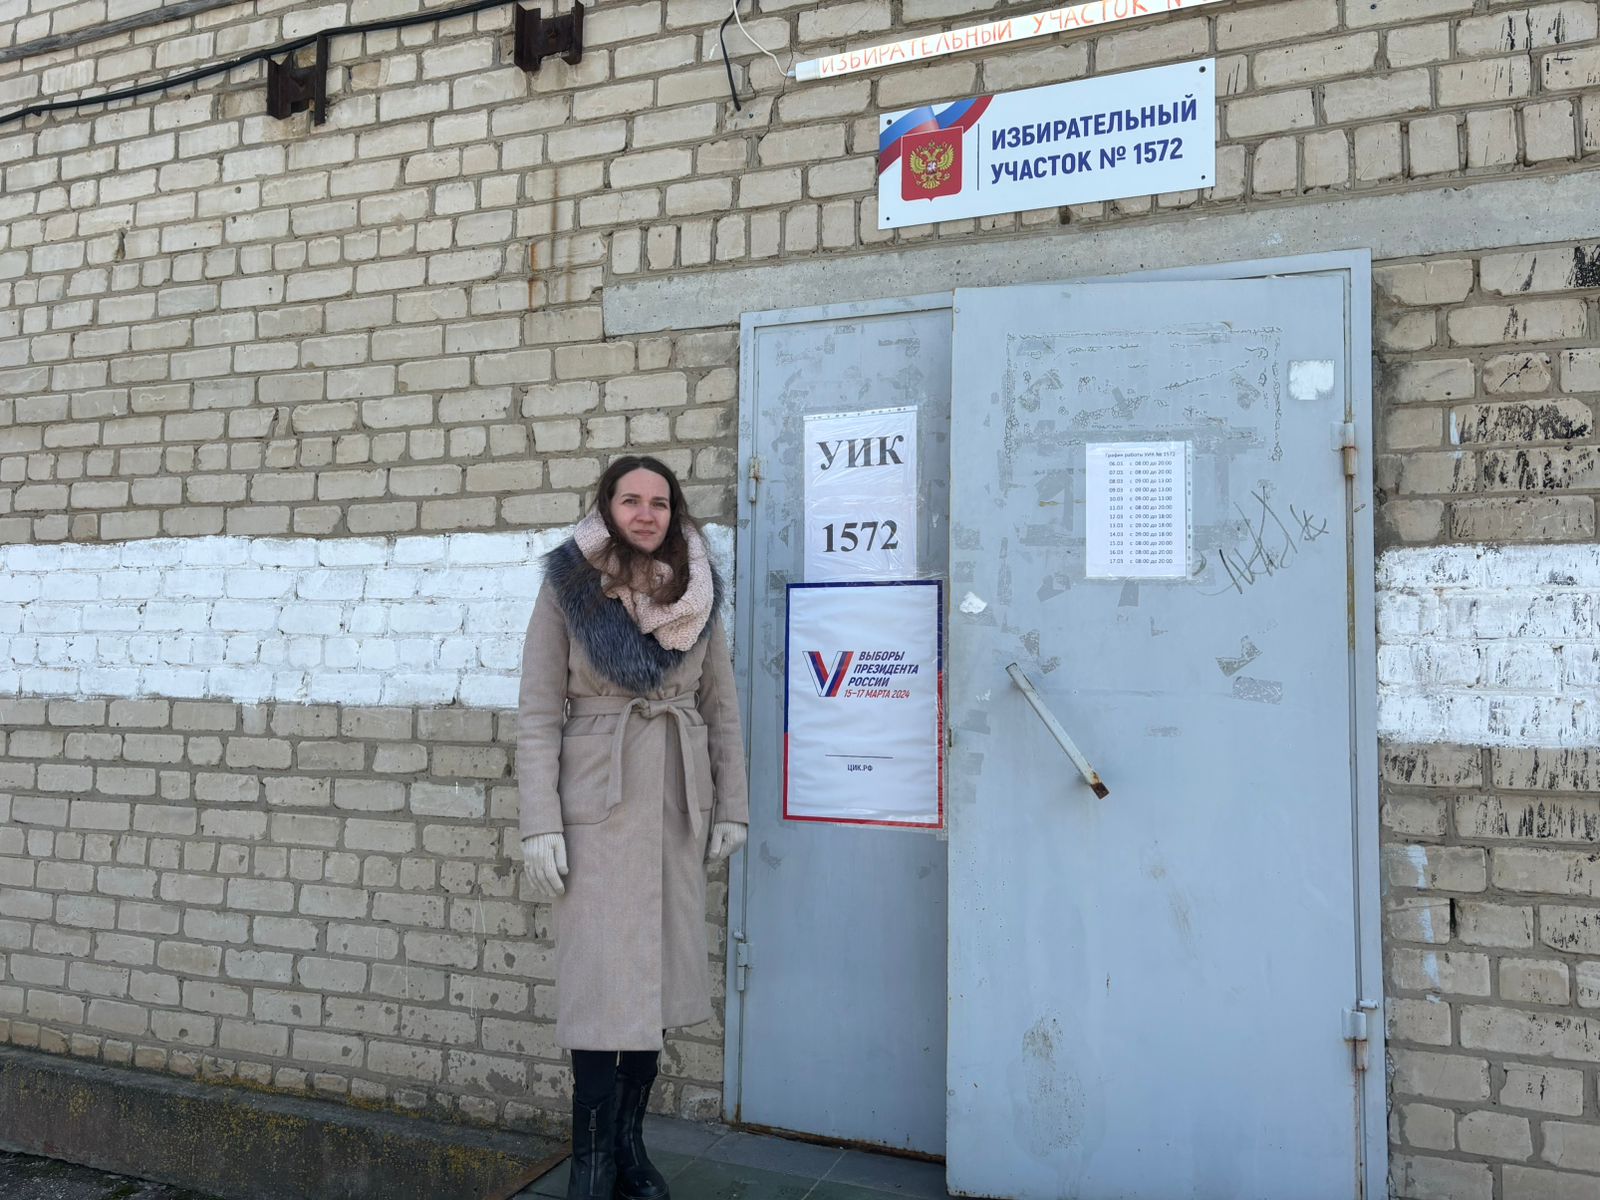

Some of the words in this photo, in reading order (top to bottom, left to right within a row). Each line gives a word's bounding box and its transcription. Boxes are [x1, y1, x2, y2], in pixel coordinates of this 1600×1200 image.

[991, 93, 1197, 151] ИЗБИРАТЕЛЬНЫЙ
[991, 150, 1093, 185] УЧАСТОК
[1099, 145, 1127, 170] №
[1133, 137, 1184, 165] 1572
[816, 435, 904, 471] УИК
[822, 520, 899, 553] 1572
[858, 651, 905, 661] ВЫБОРЫ
[853, 664, 919, 676] ПРЕЗИДЕНТА
[847, 677, 890, 687] РОССИИ
[865, 689, 890, 698] МАРТА
[891, 689, 910, 699] 2024
[847, 764, 874, 772] ЦИК.РФ
